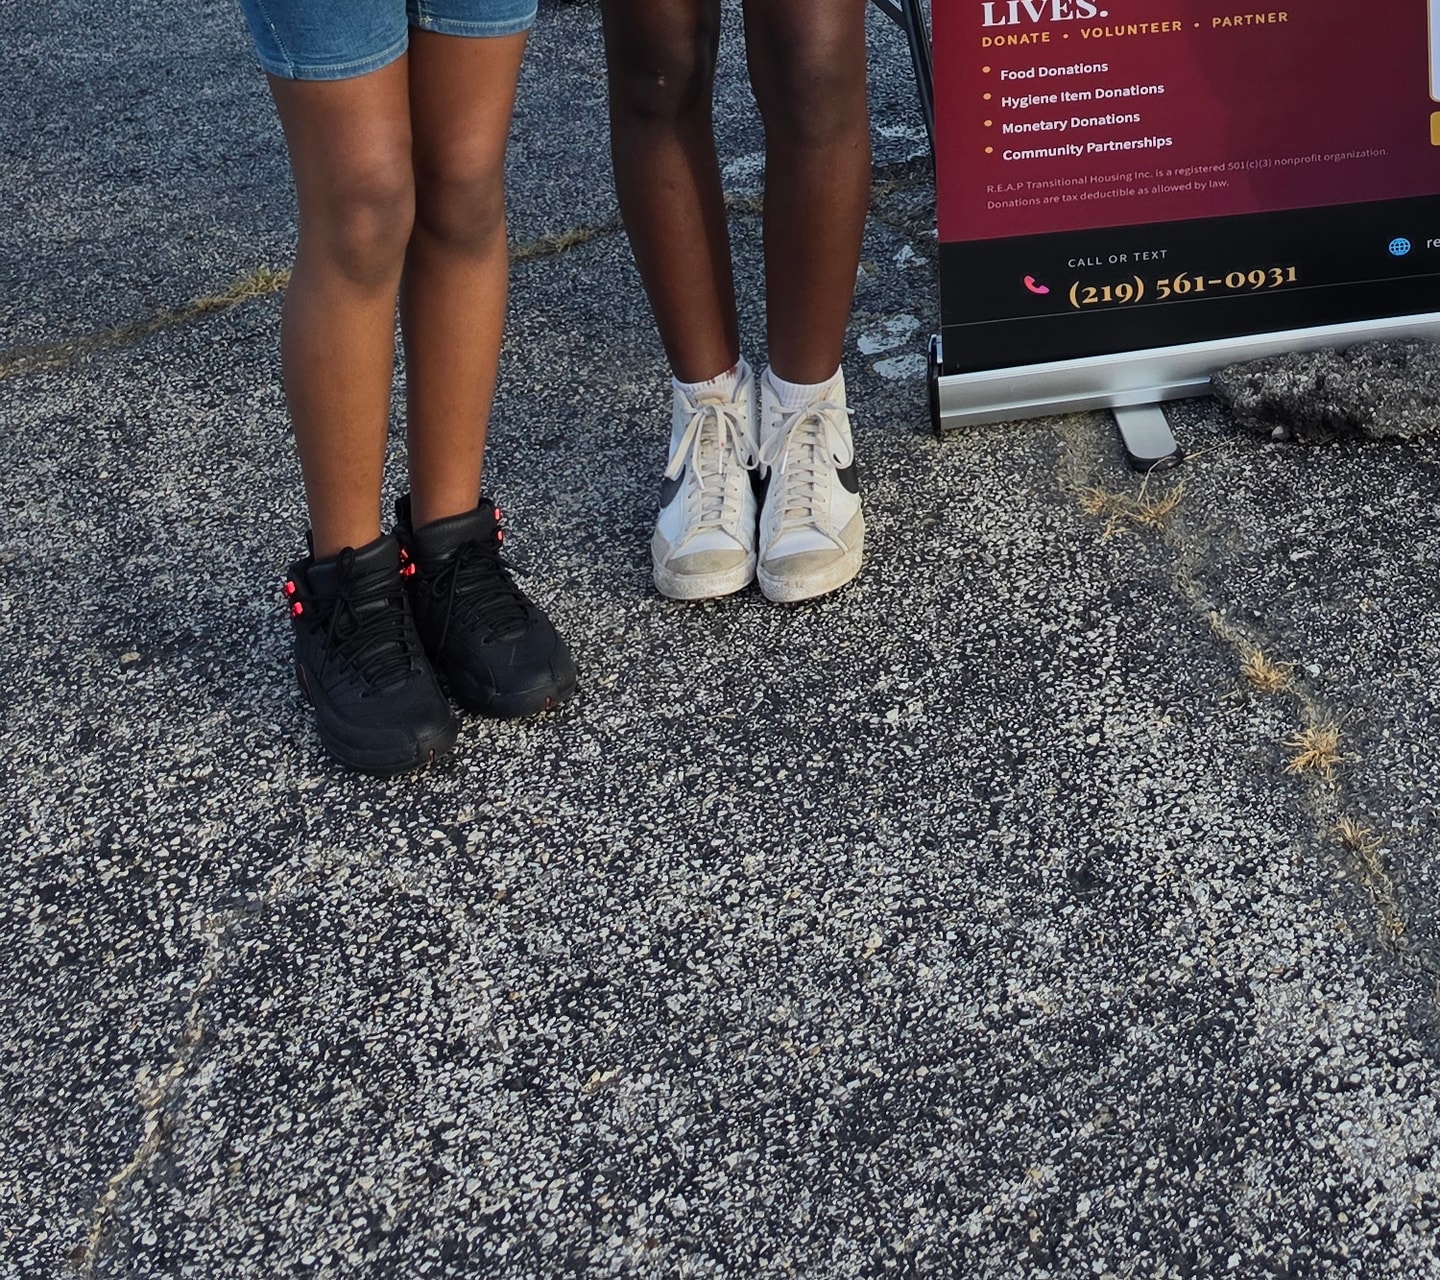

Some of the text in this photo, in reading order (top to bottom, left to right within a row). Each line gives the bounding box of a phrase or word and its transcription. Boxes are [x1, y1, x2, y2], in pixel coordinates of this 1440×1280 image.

[982, 12, 1289, 48] DONATE VOLUNTEER PARTNER
[1000, 61, 1109, 81] Food Donations
[1001, 83, 1165, 110] Hygiene Item Donations
[1002, 111, 1140, 136] Monetary Donations
[1003, 135, 1173, 162] Community Partnerships
[987, 182, 1024, 194] R.E.A.P
[1026, 176, 1088, 190] Transitional
[1090, 173, 1133, 186] Housing
[1135, 171, 1153, 180] Inc.
[1156, 169, 1164, 177] is
[1175, 162, 1225, 177] registered
[1228, 158, 1272, 172] 501(c)(3)
[1275, 154, 1322, 168] nonprofit
[1324, 148, 1389, 163] organization.
[987, 179, 1229, 210] Donations are tax deductible as allowed by law.
[1068, 250, 1168, 268] CALL OR TEXT
[1068, 264, 1298, 309] (219) 561-0931
